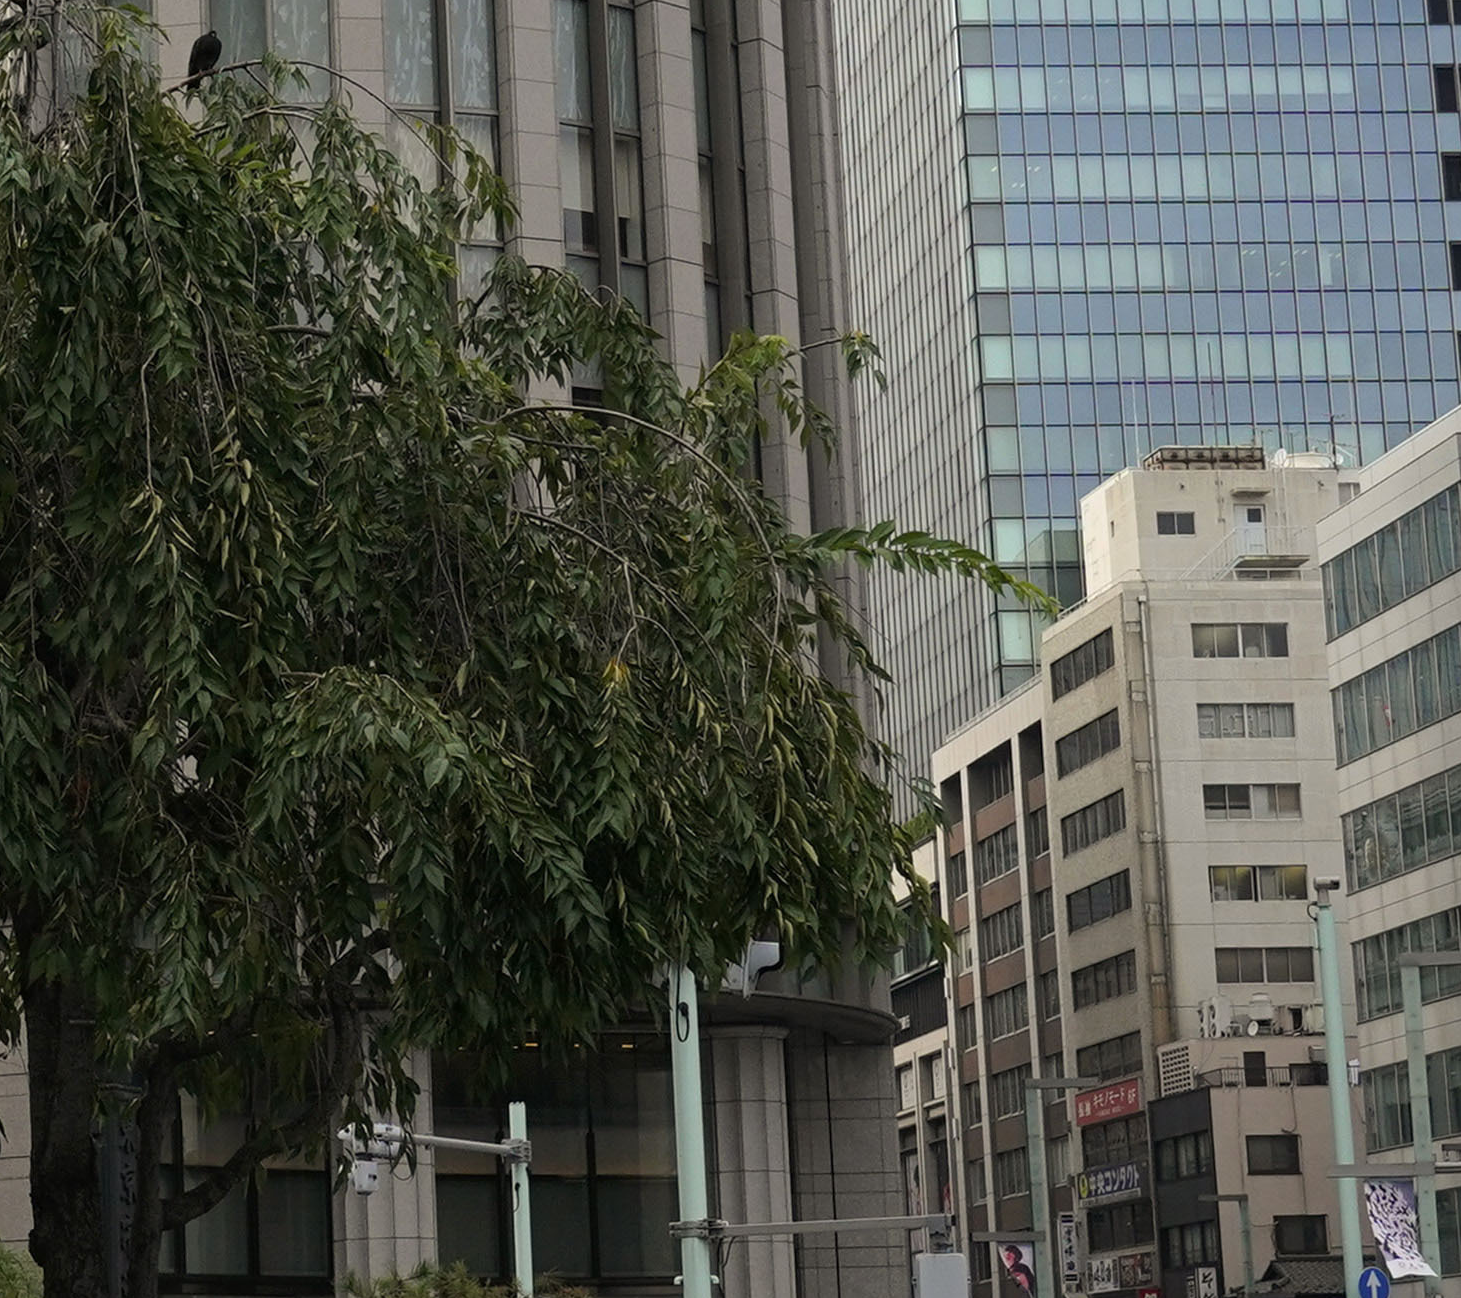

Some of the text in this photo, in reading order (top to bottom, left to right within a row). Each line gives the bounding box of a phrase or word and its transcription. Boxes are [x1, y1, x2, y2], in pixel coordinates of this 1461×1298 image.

[1089, 1164, 1141, 1197] 中央コンタクト
